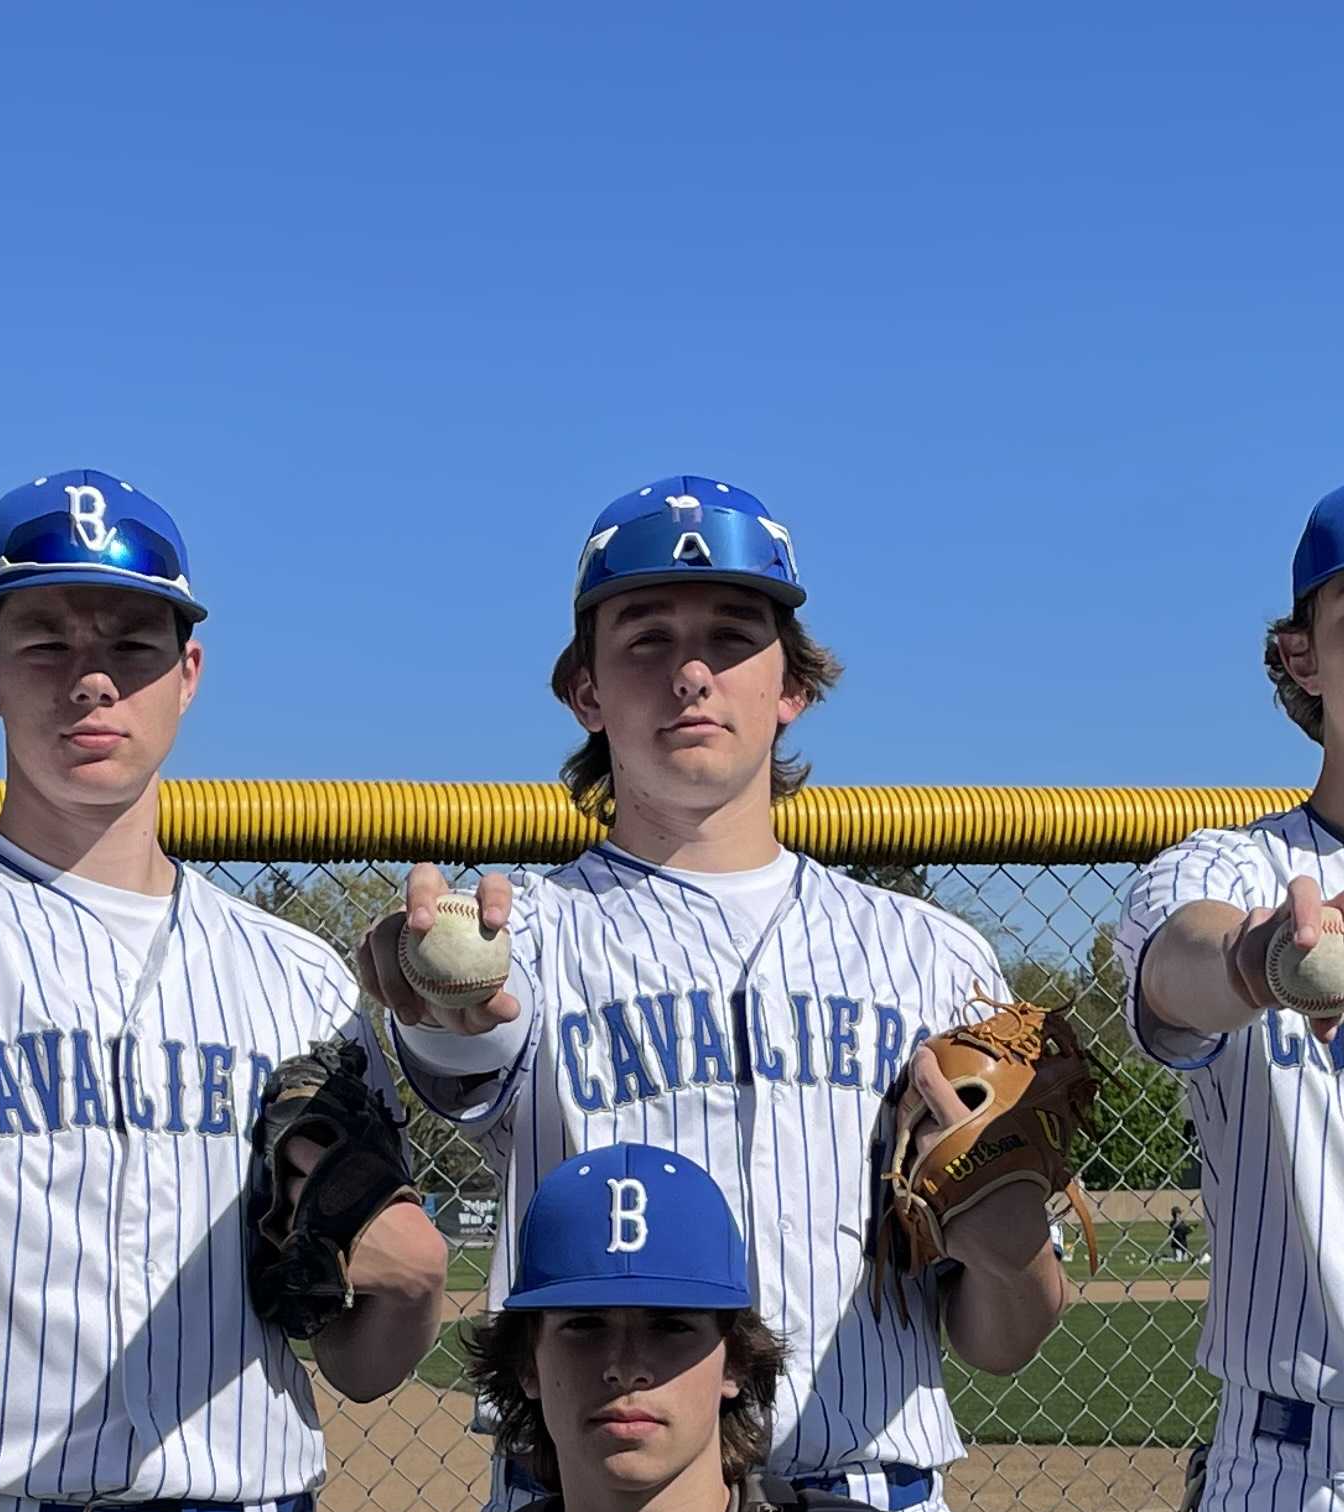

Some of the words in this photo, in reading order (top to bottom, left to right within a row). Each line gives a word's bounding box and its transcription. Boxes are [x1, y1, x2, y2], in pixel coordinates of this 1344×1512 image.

[560, 985, 930, 1116] CAVALIER
[944, 1134, 1026, 1182] Wilson
[606, 1178, 648, 1253] B
